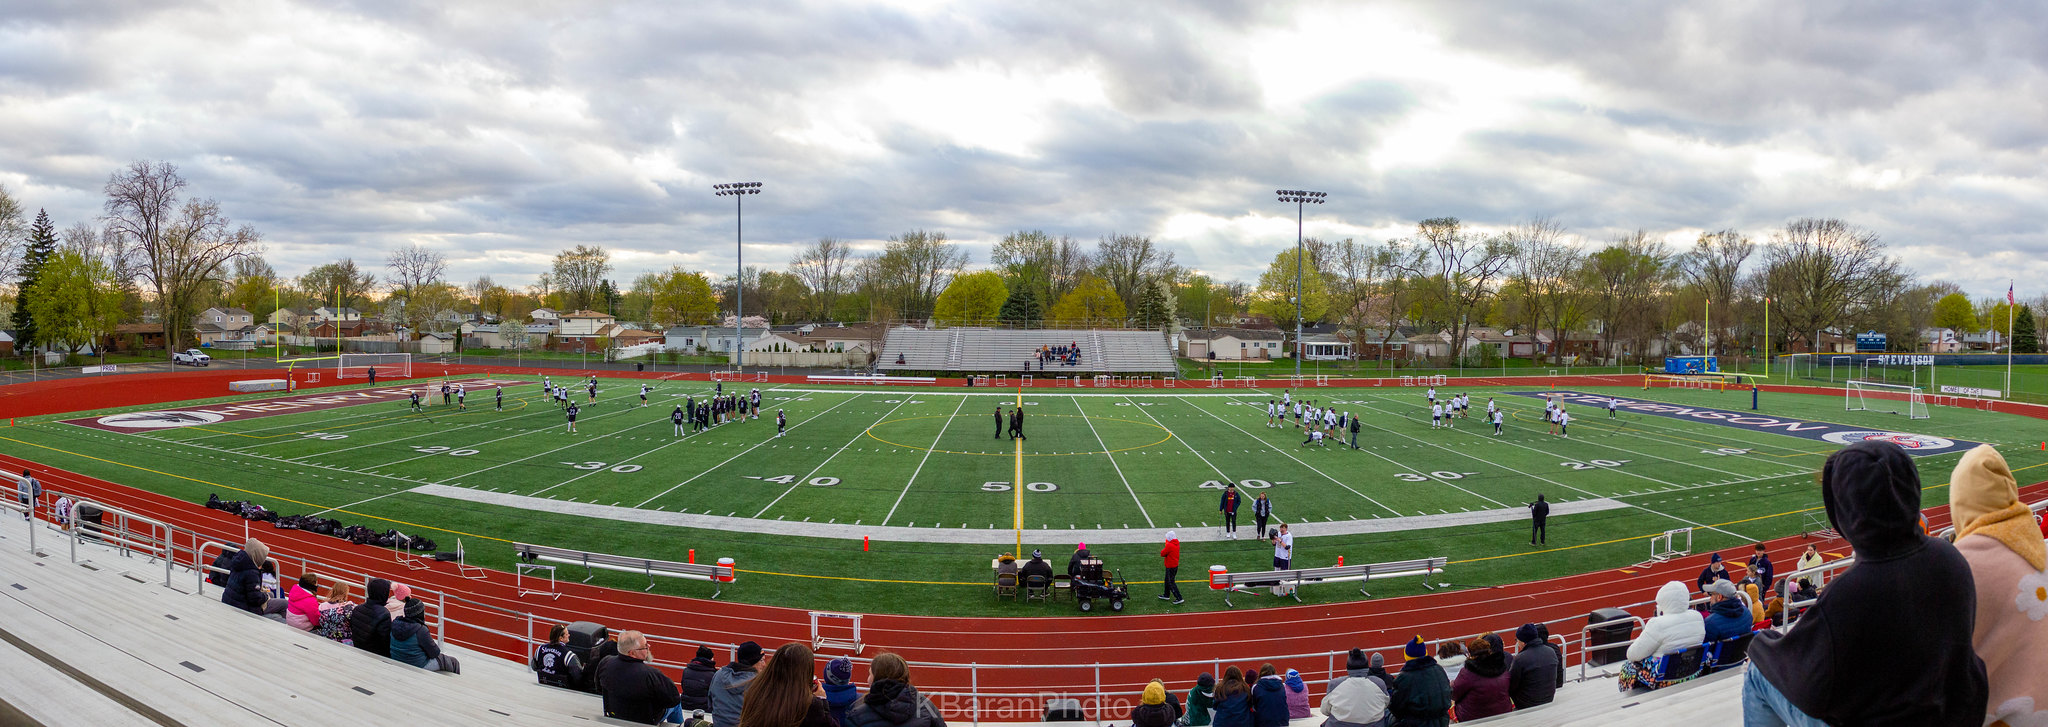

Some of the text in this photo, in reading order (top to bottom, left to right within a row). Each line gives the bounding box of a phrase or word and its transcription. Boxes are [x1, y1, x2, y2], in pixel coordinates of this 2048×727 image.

[1878, 355, 1935, 365] STEVENSON
[1536, 392, 1829, 431] STEVENSON
[416, 446, 481, 457] 20
[574, 461, 643, 473] 30
[1560, 459, 1622, 470] 20
[763, 474, 842, 487] 40
[1394, 471, 1463, 482] 30
[981, 481, 1058, 492] 50
[1199, 479, 1272, 489] 40
